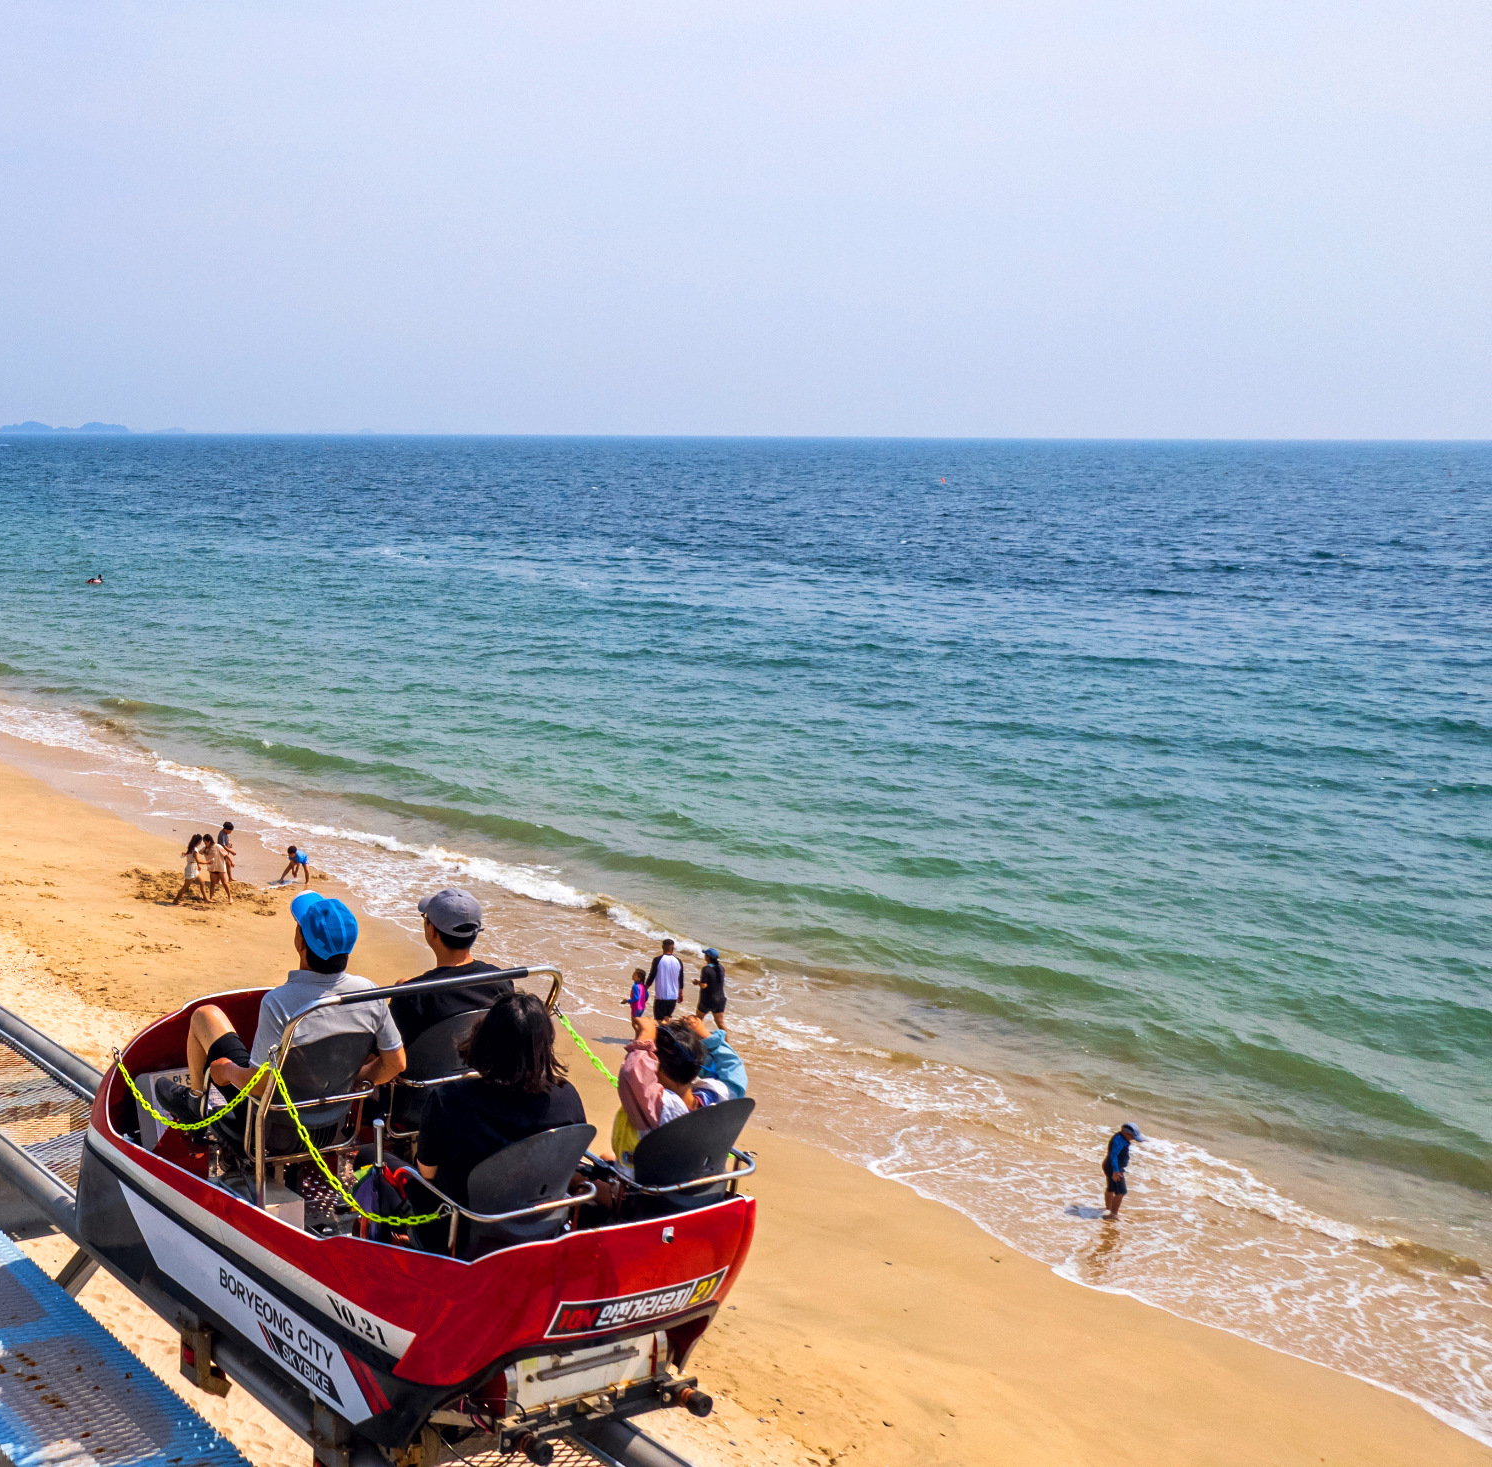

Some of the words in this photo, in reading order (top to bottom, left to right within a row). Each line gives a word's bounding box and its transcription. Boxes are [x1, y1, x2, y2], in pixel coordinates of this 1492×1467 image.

[219, 1266, 294, 1342] BORYEONG
[297, 1329, 334, 1370] CITY
[595, 1286, 692, 1327] 안전거리유지
[689, 1277, 718, 1305] 21
[281, 1344, 330, 1395] SKYBIKE
